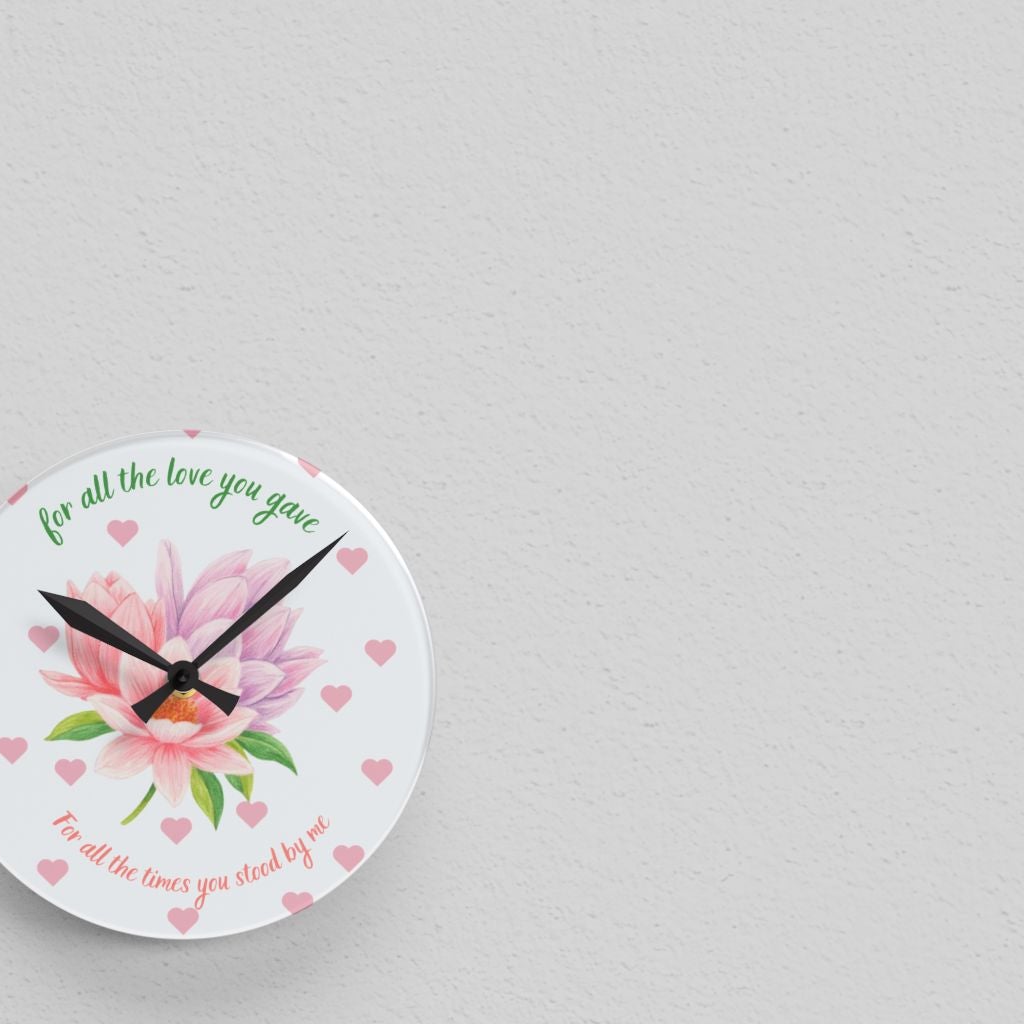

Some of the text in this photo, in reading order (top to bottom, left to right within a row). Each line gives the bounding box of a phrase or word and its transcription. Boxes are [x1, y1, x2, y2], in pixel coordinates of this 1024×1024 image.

[39, 456, 320, 546] for all the love you gave
[52, 810, 331, 911] For all the times you stood by me
